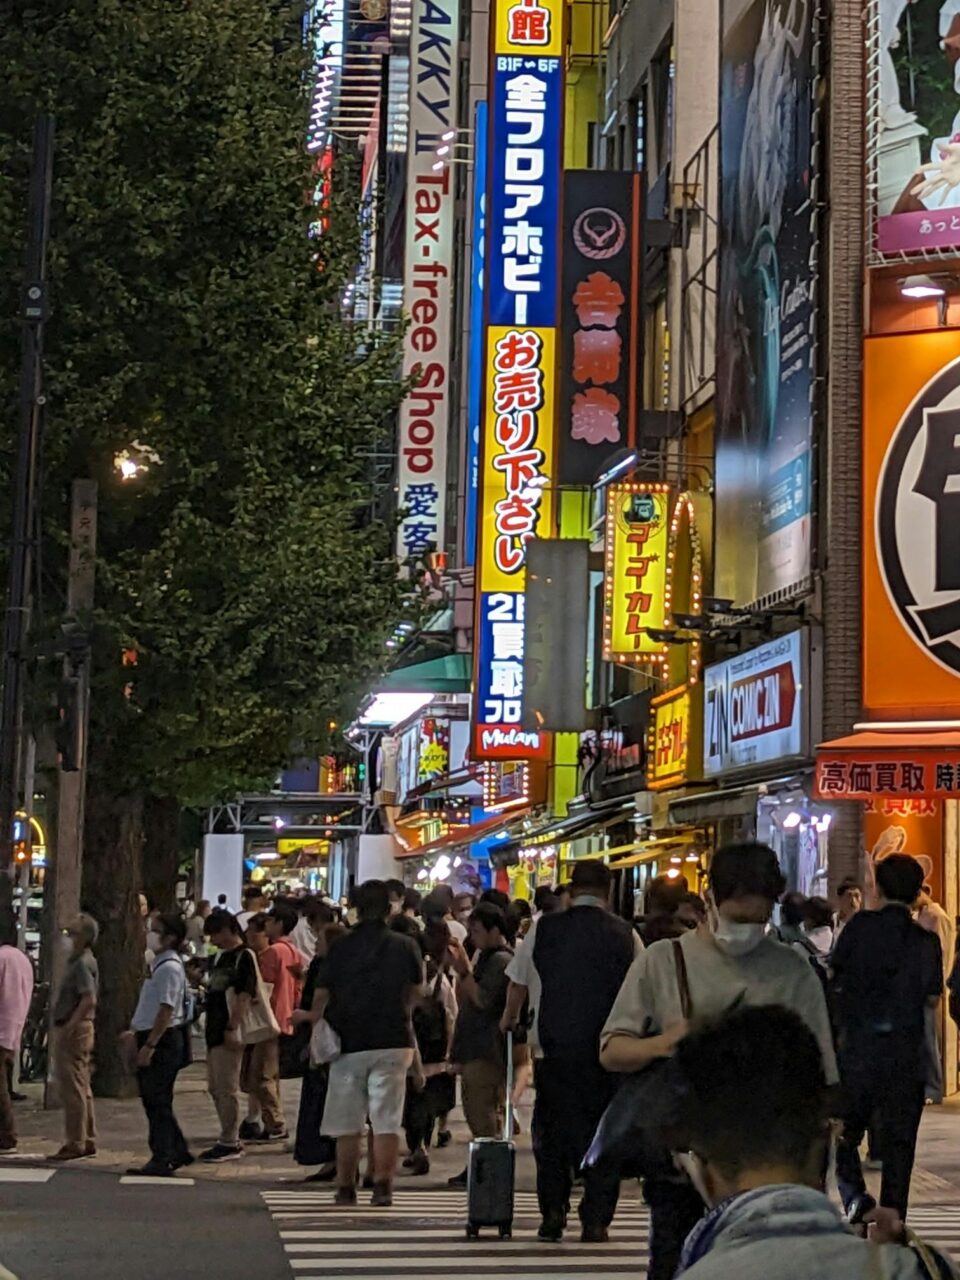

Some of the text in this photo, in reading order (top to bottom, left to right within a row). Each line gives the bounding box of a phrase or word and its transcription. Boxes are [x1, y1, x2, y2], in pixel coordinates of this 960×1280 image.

[501, 74, 548, 325] 全フロアホビー
[404, 166, 450, 474] Tax-free Shop
[487, 592, 525, 621] 2
[625, 521, 660, 650] ゴーゴーカレー
[731, 677, 763, 737] COMIC
[481, 728, 541, 751] Mulan
[821, 761, 926, 794] 高価買取
